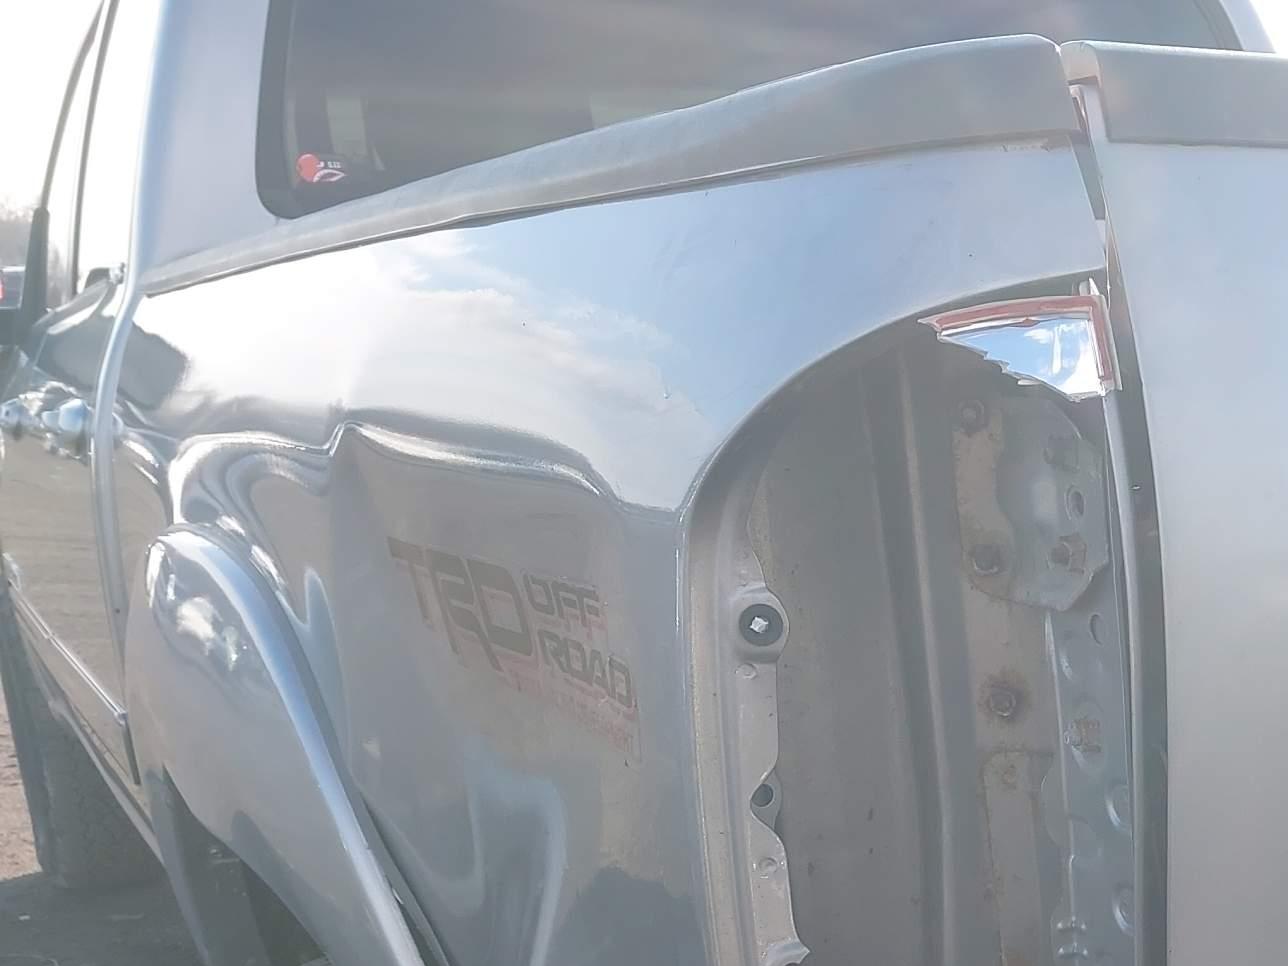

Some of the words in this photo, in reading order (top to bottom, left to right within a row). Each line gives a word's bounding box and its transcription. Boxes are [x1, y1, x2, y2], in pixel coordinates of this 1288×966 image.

[386, 535, 534, 673] TRD
[522, 571, 601, 626] OFF
[540, 630, 633, 709] ROAD
